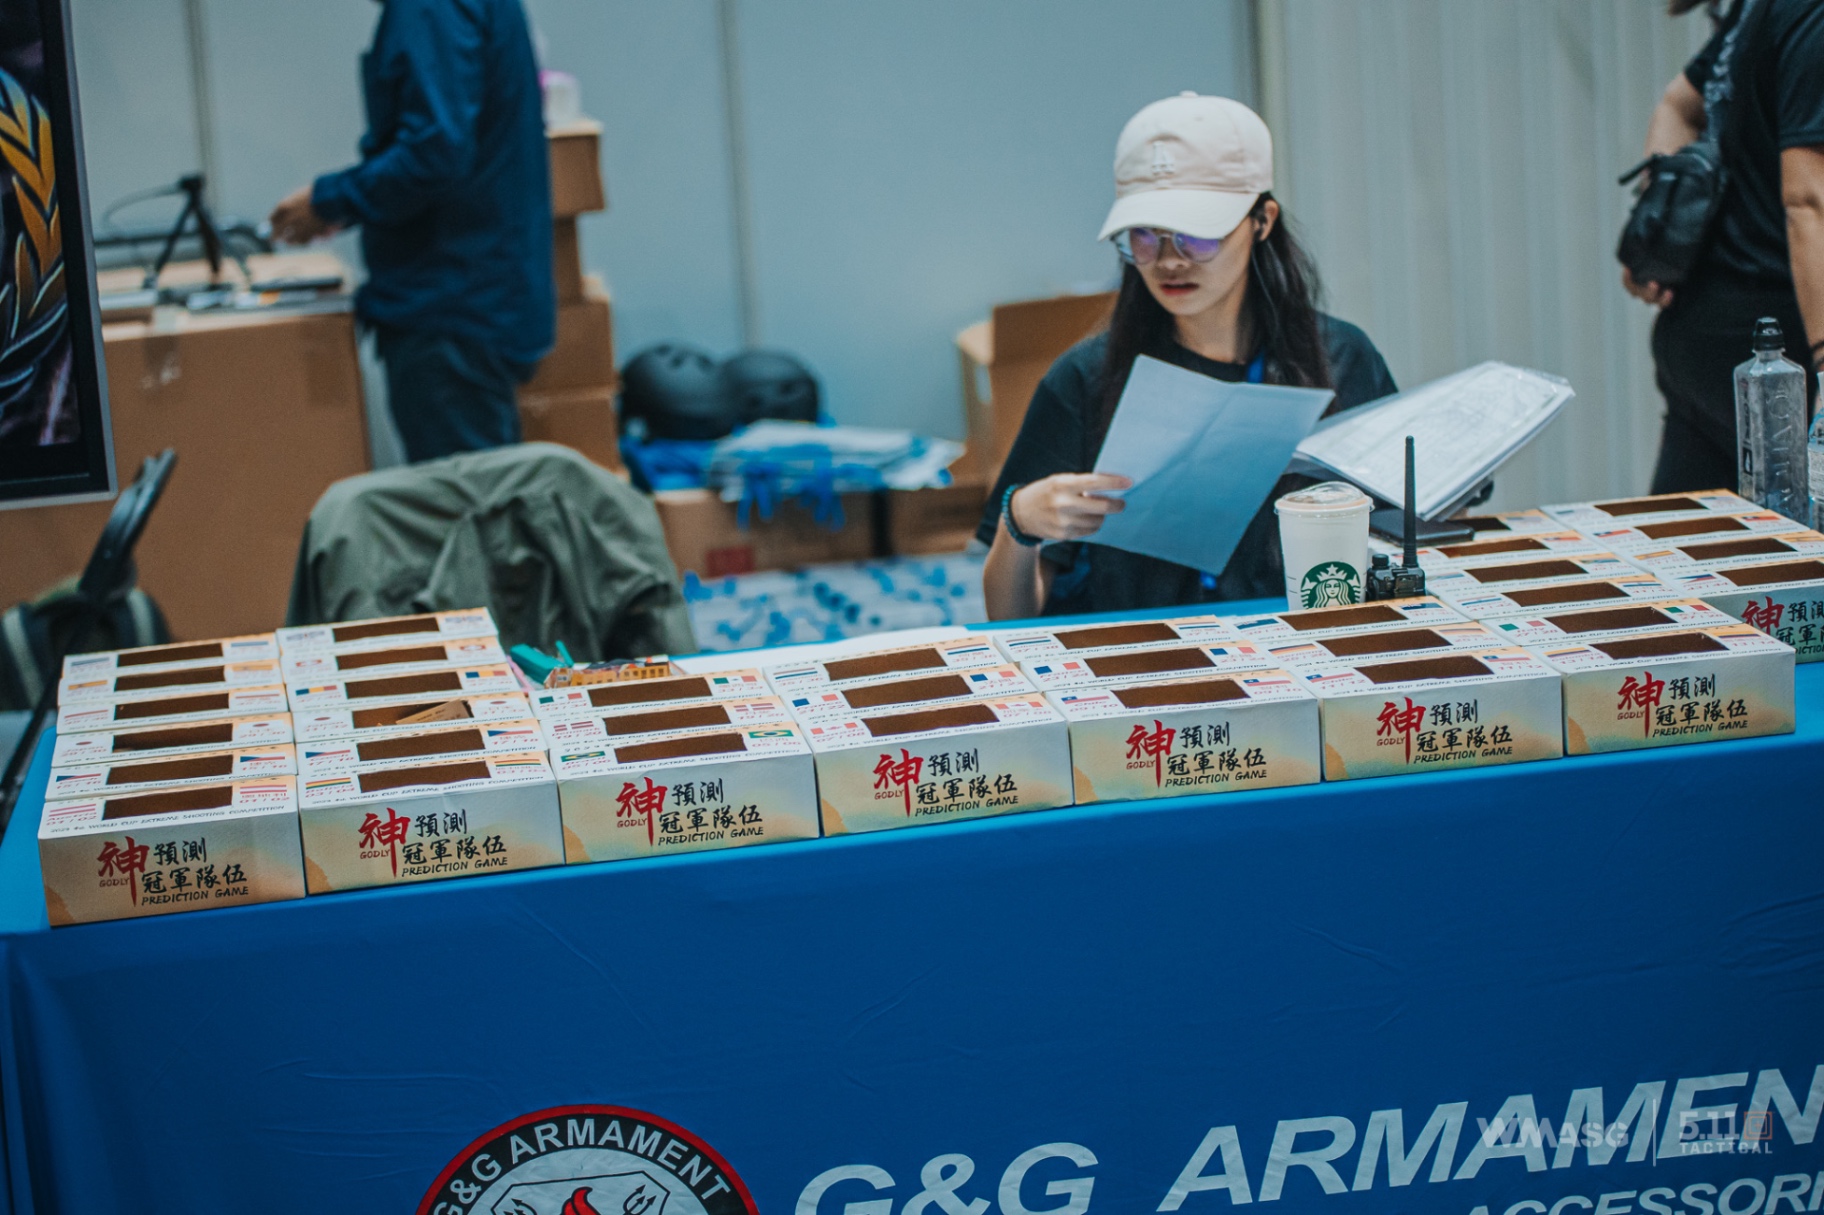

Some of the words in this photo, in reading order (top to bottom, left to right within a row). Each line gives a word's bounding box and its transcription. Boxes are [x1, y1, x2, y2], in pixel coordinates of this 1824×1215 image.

[1741, 596, 1785, 635] 神
[1776, 624, 1824, 646] 冠軍
[1668, 674, 1715, 700] 預測
[1430, 699, 1478, 726] 預測
[1617, 671, 1665, 738] 神
[1618, 711, 1645, 720] GODLY
[1656, 699, 1747, 726] 冠軍隊伍
[1180, 722, 1230, 749] 預測
[1377, 697, 1426, 765] 神
[1377, 737, 1405, 746] GODLY
[1416, 725, 1512, 752] 冠軍隊伍
[1653, 724, 1713, 737] PREDICTION
[1718, 720, 1748, 730] GAME
[928, 749, 979, 777] 預測
[1126, 719, 1176, 788] 神
[1127, 760, 1156, 770] GODLY
[1166, 748, 1267, 775] 冠軍隊伍
[1414, 751, 1476, 764] PREDICTION
[1482, 746, 1512, 757] GAME
[488, 776, 543, 784] COMPETITION
[672, 778, 723, 806] 預測
[873, 748, 924, 817] 神
[915, 774, 1017, 804] 冠軍隊伍
[1165, 773, 1229, 787] PREDICTION
[1236, 770, 1267, 780] GAME
[874, 790, 904, 800] GODLY
[915, 802, 980, 817] PREDICTION
[986, 796, 1018, 807] GAME
[414, 809, 466, 837] 預測
[616, 777, 668, 846] 神
[617, 818, 647, 827] GODLY
[658, 804, 762, 834] 冠軍隊伍
[358, 808, 410, 879] 神
[658, 831, 724, 845] PREDICTION
[731, 826, 763, 837] GAME
[154, 838, 206, 865] 預測
[360, 850, 390, 859] GODLY
[402, 835, 506, 864] 冠軍隊伍
[97, 836, 150, 907] 神
[142, 864, 247, 893] 冠軍隊伍
[402, 862, 468, 877] PREDICTION
[475, 857, 507, 868] GAME
[99, 878, 130, 887] GODLY
[142, 890, 208, 906] PREDICTION
[216, 887, 248, 896] GAME
[510, 1118, 731, 1201] ARMAMENT
[795, 1142, 1099, 1215] G&G
